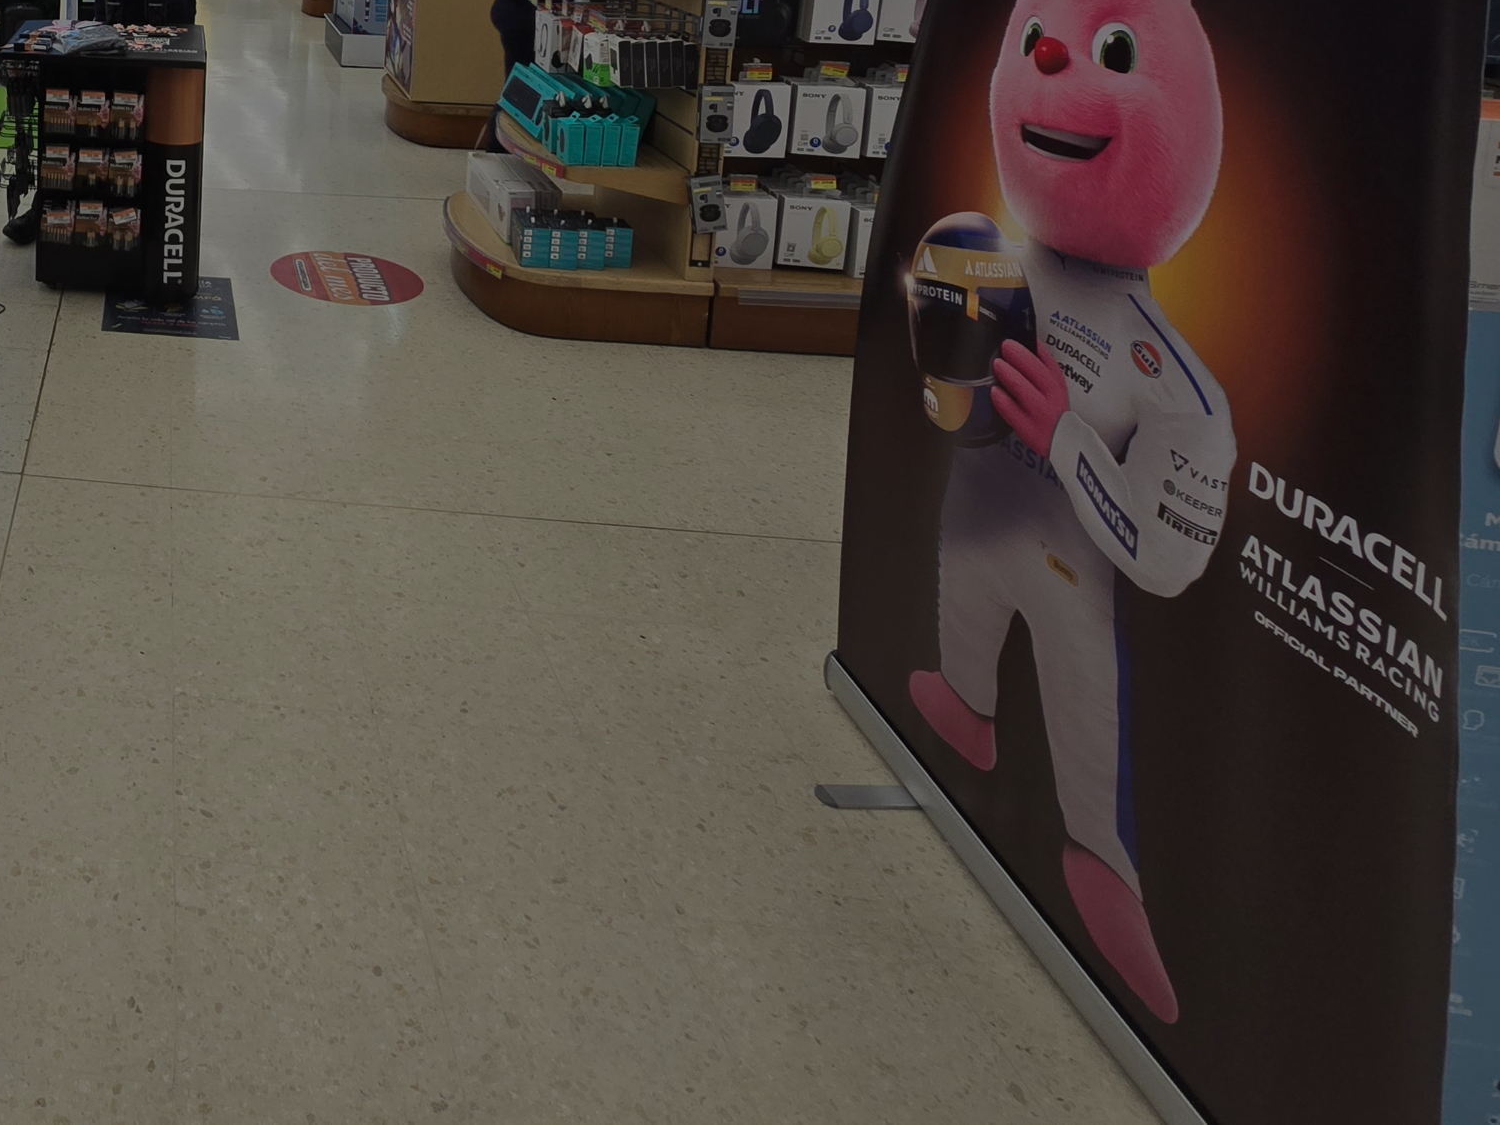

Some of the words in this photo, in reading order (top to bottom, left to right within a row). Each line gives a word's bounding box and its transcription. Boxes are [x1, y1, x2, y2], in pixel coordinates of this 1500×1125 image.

[163, 158, 186, 285] DURACELL
[974, 260, 1024, 279] ATLASSIAN
[1060, 312, 1112, 354] ATLASSIAN
[1045, 334, 1102, 378] DURACELL
[1132, 341, 1160, 376] Gulf
[1189, 467, 1228, 492] VAST
[1078, 458, 1137, 552] KOMATSU
[1157, 501, 1219, 546] PIRELLI
[1175, 488, 1223, 519] KEEPER
[1248, 461, 1448, 622] DURACELL
[1240, 534, 1443, 699] ATLASSIAN
[1254, 609, 1331, 673] OFFICIAL
[1333, 665, 1419, 739] PARTNER
